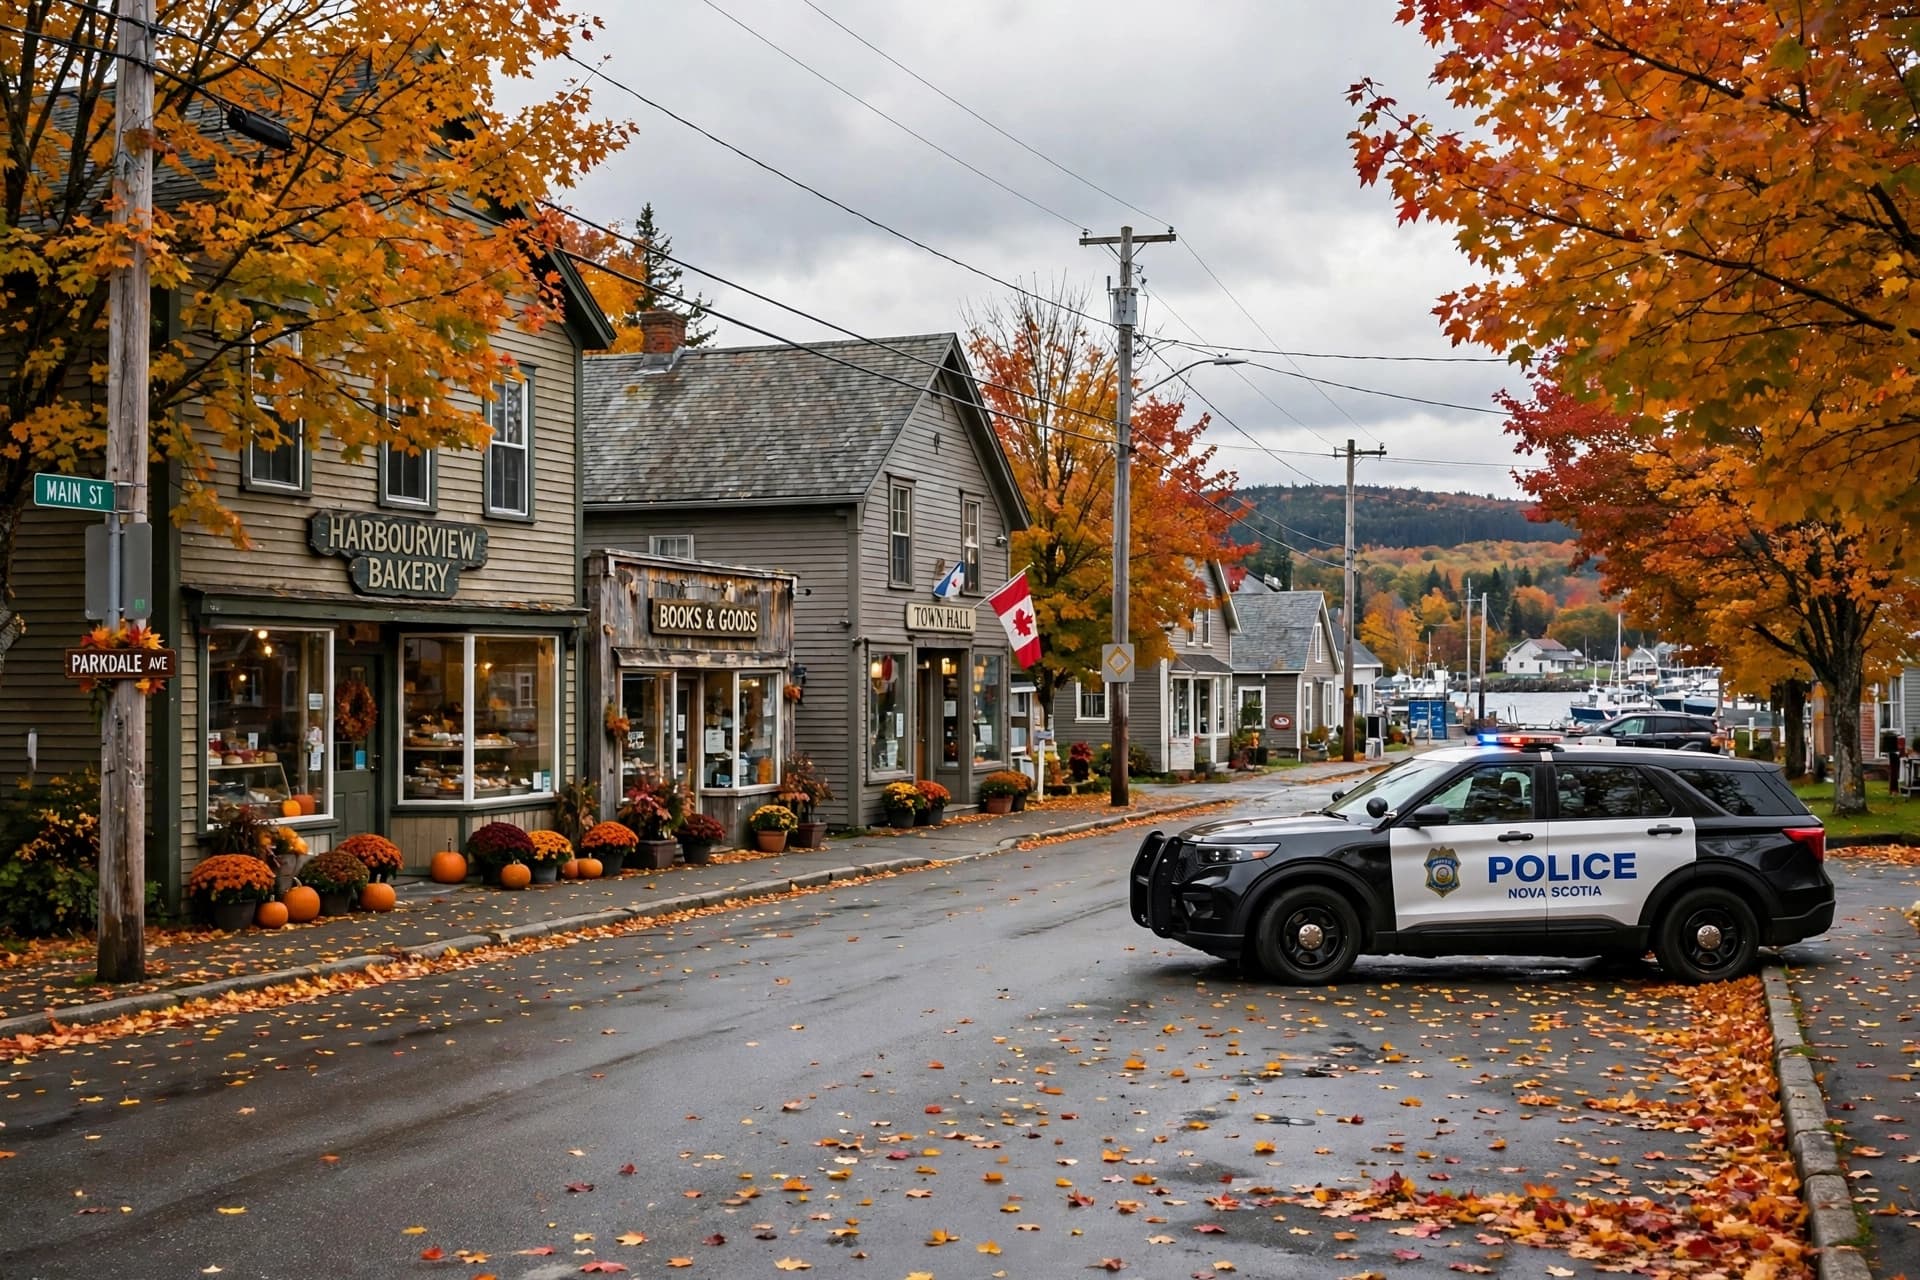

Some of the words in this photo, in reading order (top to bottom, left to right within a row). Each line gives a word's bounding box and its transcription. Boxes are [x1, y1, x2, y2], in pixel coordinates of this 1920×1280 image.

[46, 480, 81, 504] MAIN
[89, 485, 104, 505] ST
[329, 516, 476, 560] HARBOURVIEW
[368, 557, 449, 592] BAKERY
[659, 605, 702, 629] BOOKS
[706, 609, 715, 630] &
[719, 609, 757, 632] GOODS
[914, 607, 943, 627] TOWN
[947, 609, 971, 629] HALL
[72, 654, 143, 673] PARKDALE
[148, 656, 168, 671] AVE
[1488, 852, 1637, 883] POLICE
[1508, 887, 1546, 899] NOVA
[1551, 885, 1602, 897] SCOTIA
